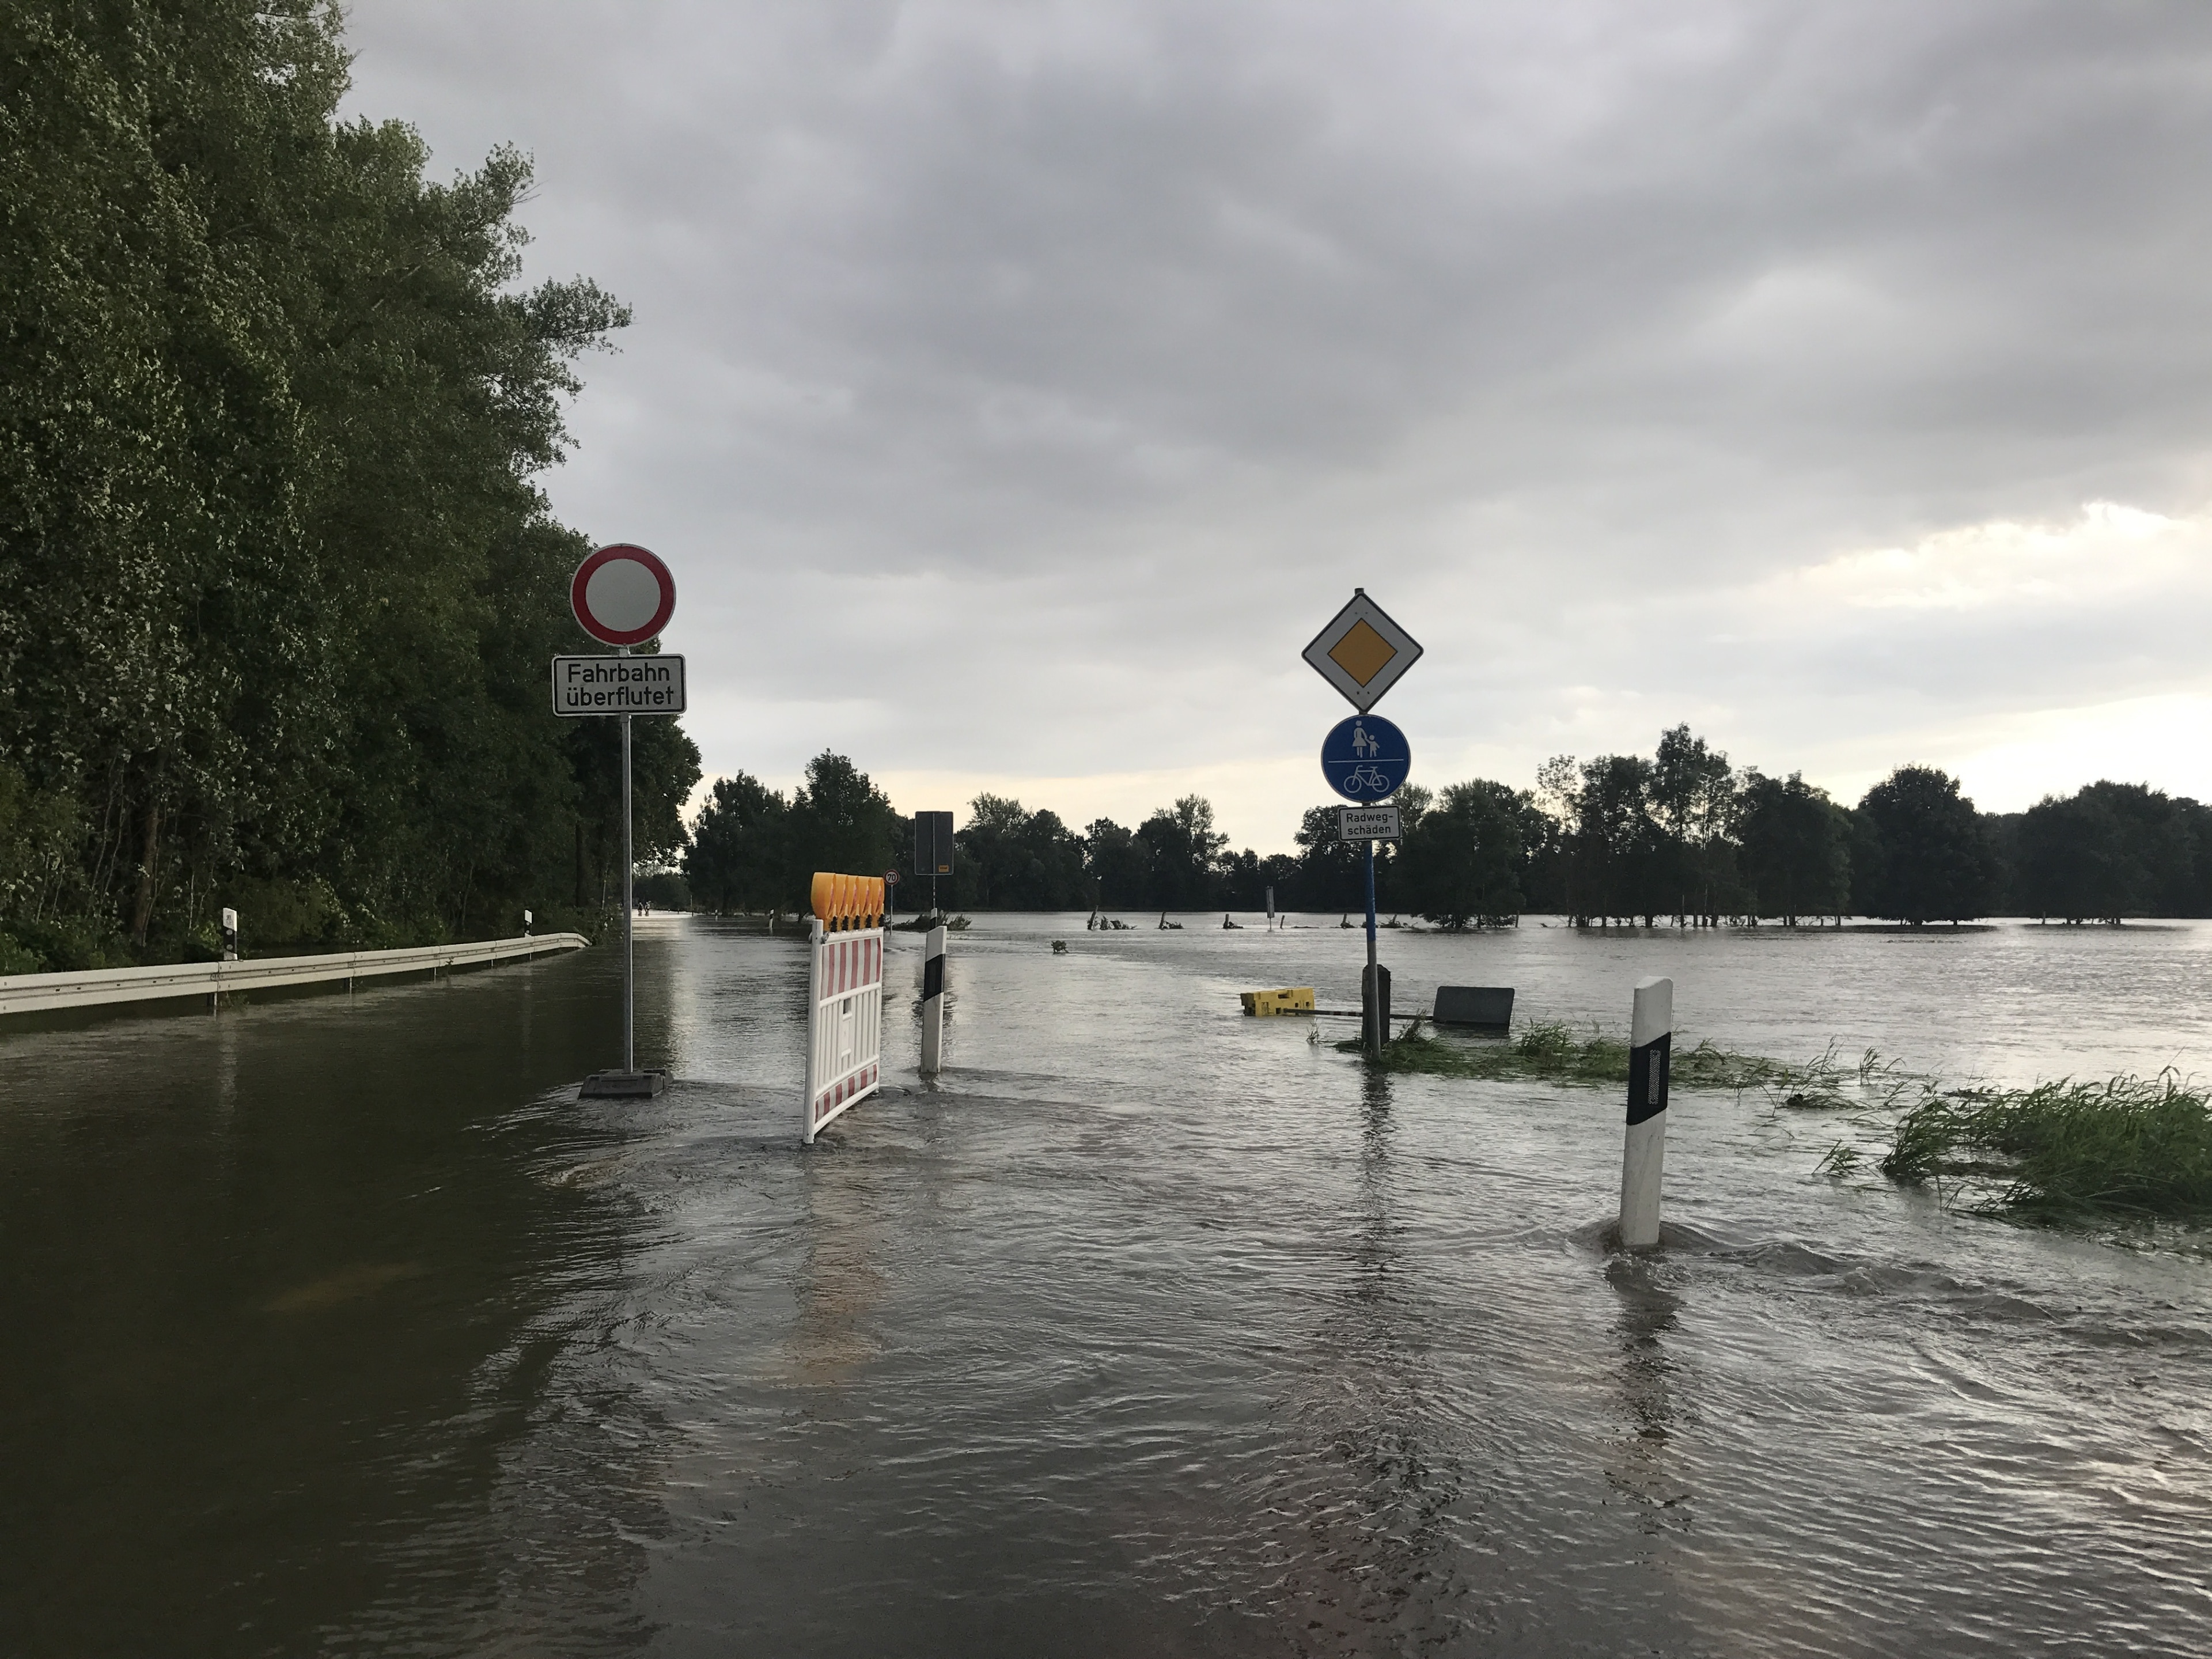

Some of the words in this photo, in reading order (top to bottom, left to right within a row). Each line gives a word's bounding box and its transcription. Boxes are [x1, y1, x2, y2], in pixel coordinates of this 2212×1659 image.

[567, 662, 670, 683] Fahrbahn
[566, 685, 674, 706] überflutet
[1346, 813, 1393, 823] Radweg-
[1347, 825, 1391, 835] schäden
[887, 873, 896, 881] 70
